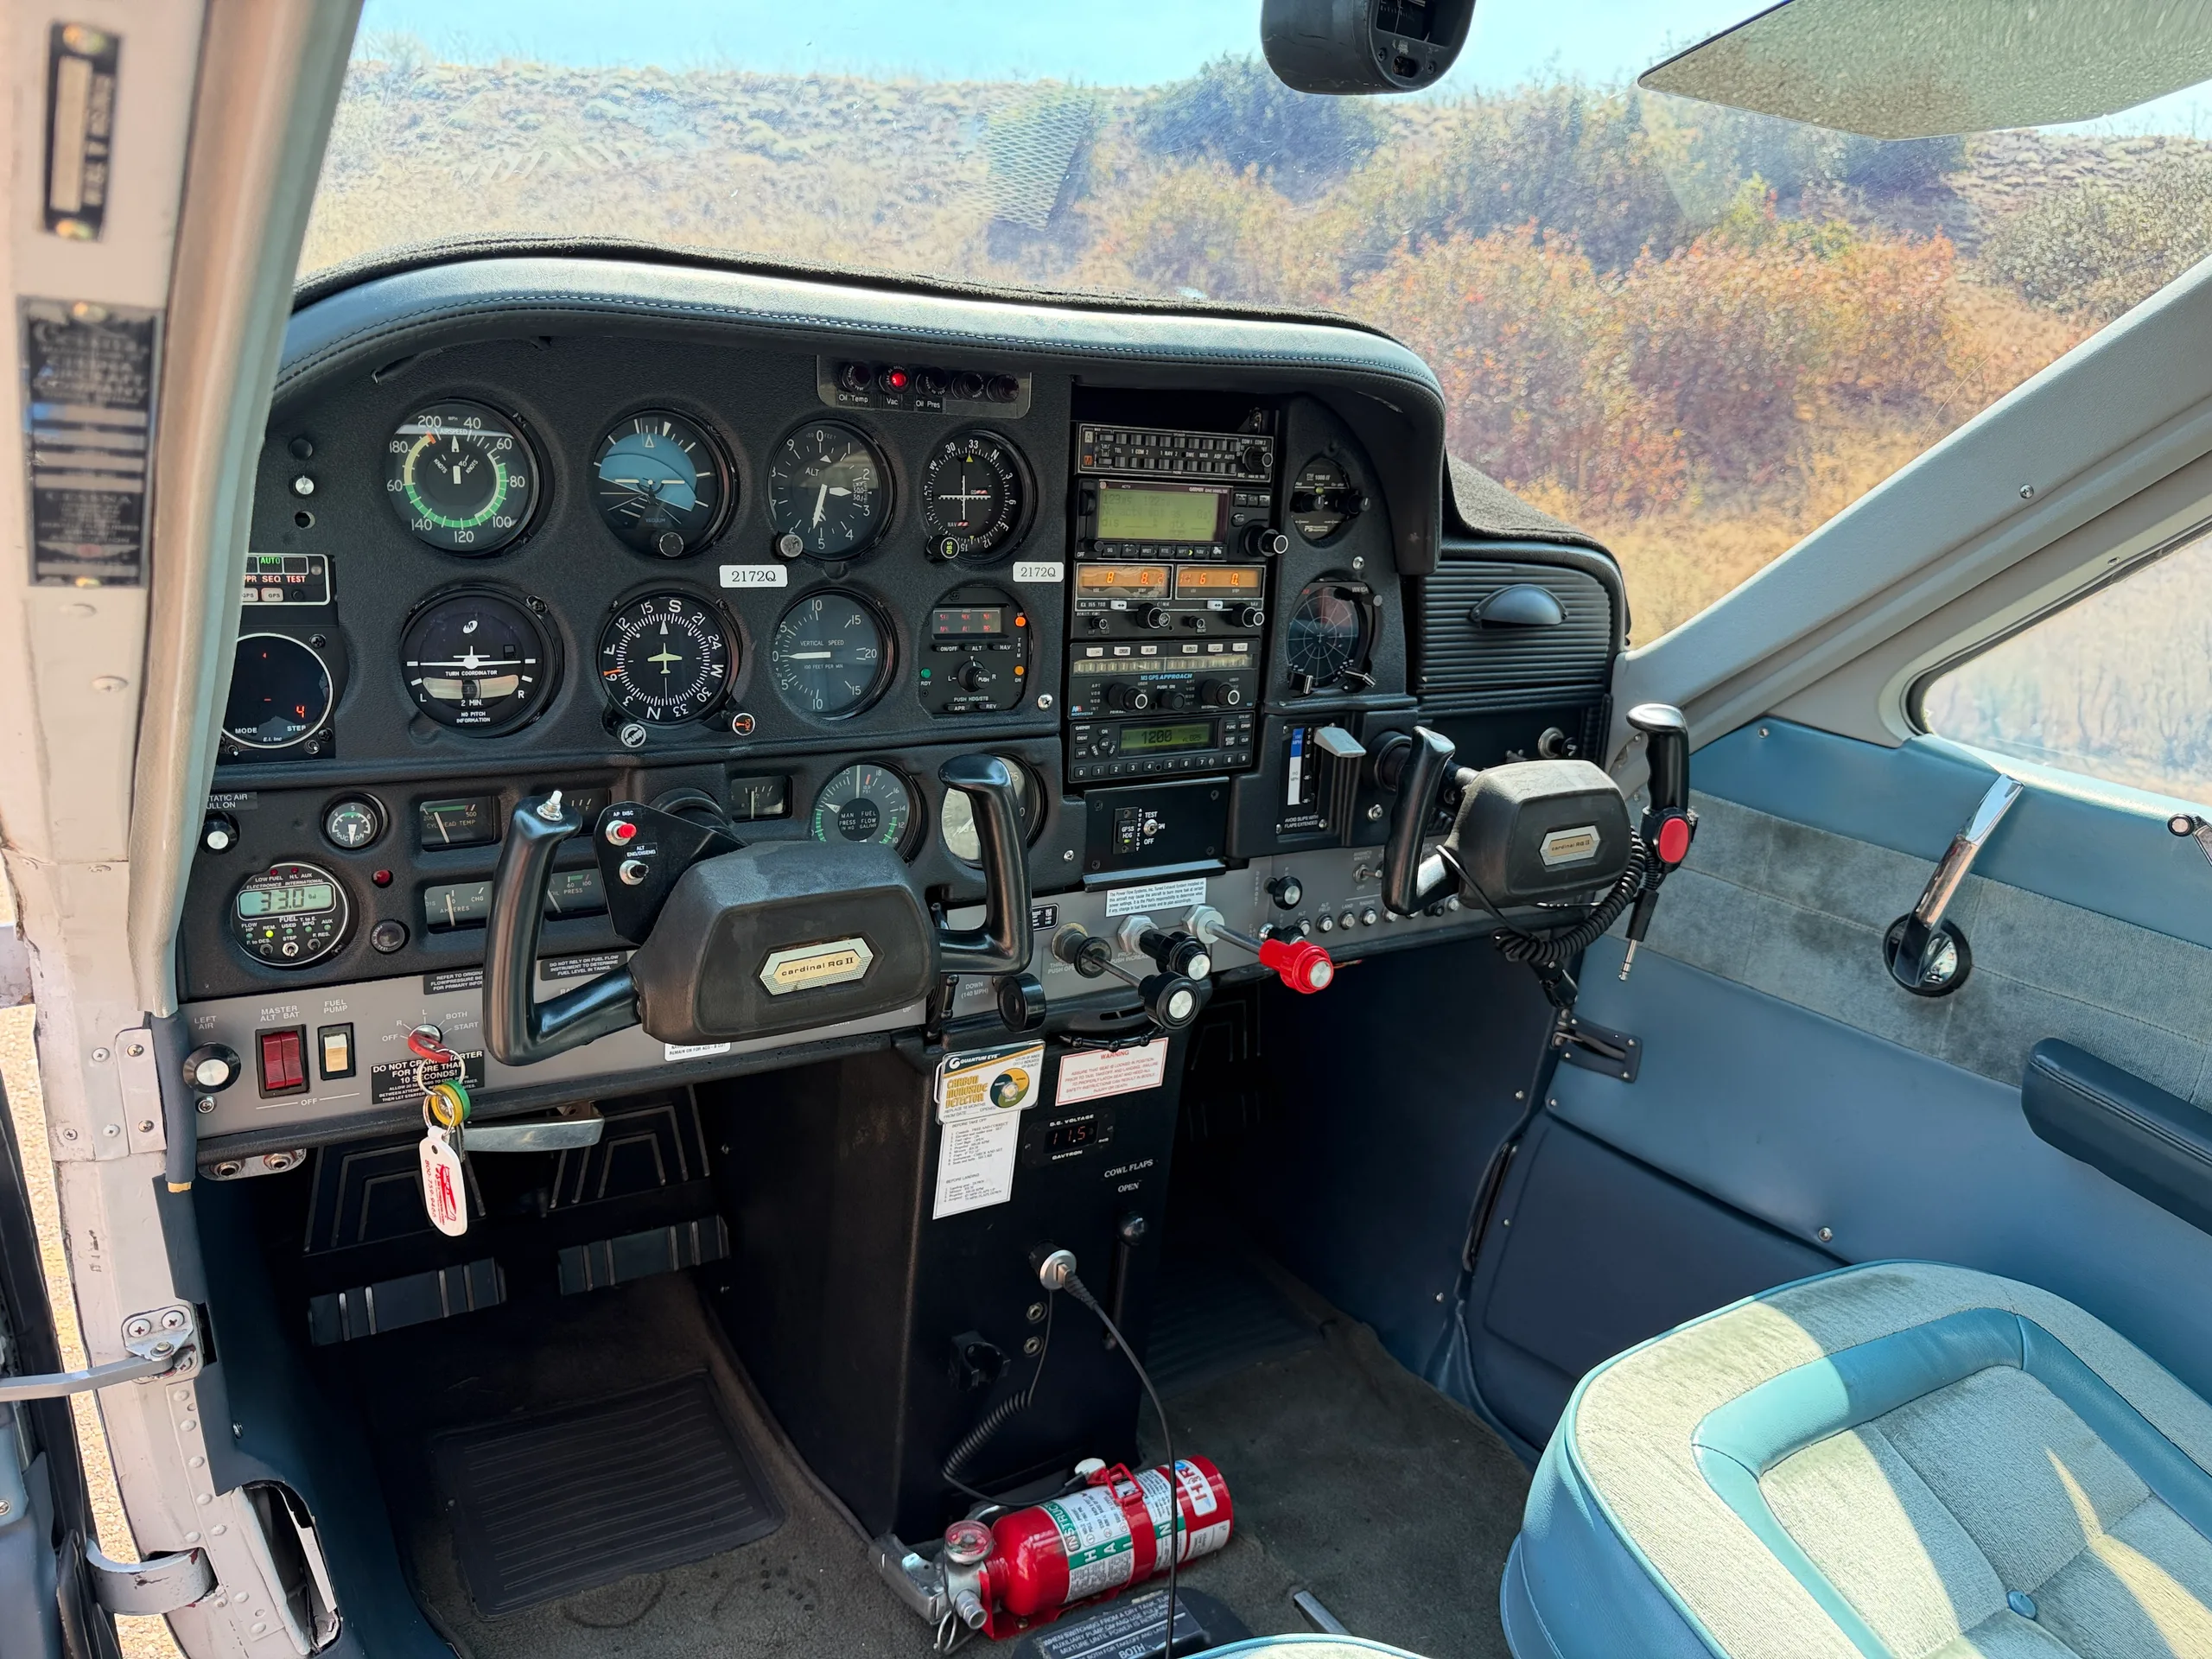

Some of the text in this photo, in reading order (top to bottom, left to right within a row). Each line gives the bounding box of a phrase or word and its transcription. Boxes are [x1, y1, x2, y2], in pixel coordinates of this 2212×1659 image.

[850, 395, 868, 404] Temp
[418, 416, 442, 429] 200
[464, 417, 481, 429] 40
[390, 441, 408, 453] 180
[497, 438, 512, 450] 60
[945, 442, 956, 453] 30
[969, 440, 978, 448] 33
[434, 458, 448, 474] KNOTS
[805, 467, 819, 476] ALT
[510, 476, 525, 487] 80
[411, 519, 432, 531] 140
[493, 517, 512, 528] 100
[454, 531, 474, 543] 120
[846, 530, 854, 540] 4
[818, 538, 824, 550] 5
[732, 571, 777, 582] 2172Q
[1021, 568, 1056, 577] 2172Q
[641, 602, 654, 614] 15
[669, 600, 682, 613] S
[812, 600, 822, 610] 10
[851, 615, 861, 625] 15
[708, 634, 721, 650] 24
[866, 649, 877, 658] 20
[852, 686, 861, 695] 15
[813, 699, 823, 709] 10
[647, 707, 660, 720] N
[1141, 730, 1172, 744] 1200
[781, 959, 844, 977] cardinal RG
[431, 977, 474, 986] FLOW/PRESSURE
[965, 981, 983, 989] DOWN
[261, 1006, 297, 1016] MASTER
[446, 1011, 467, 1020] BOTH
[194, 1016, 217, 1025] LEFT
[454, 1021, 479, 1031] START
[382, 1034, 398, 1043] OFF
[1101, 1050, 1129, 1059] WARNING
[413, 1070, 458, 1082] SECONDS!
[947, 1076, 979, 1089] CARBON
[946, 1083, 988, 1099] MONOXIDE
[945, 1093, 983, 1109] DETECTOR
[1065, 1115, 1094, 1124] VOLTAGE
[1052, 1150, 1083, 1160] DAVTRON
[1104, 1160, 1154, 1178] COWL FLAPS
[1118, 1182, 1139, 1192] OPEN
[1044, 1606, 1138, 1646] WHEN SWITCHING FROM DRY
[1052, 1614, 1142, 1649] AUXILIARY PUMP USE
[1060, 1624, 1133, 1655] MIXTURE UNTIL POWER
[1119, 1644, 1146, 1659] BOTH
